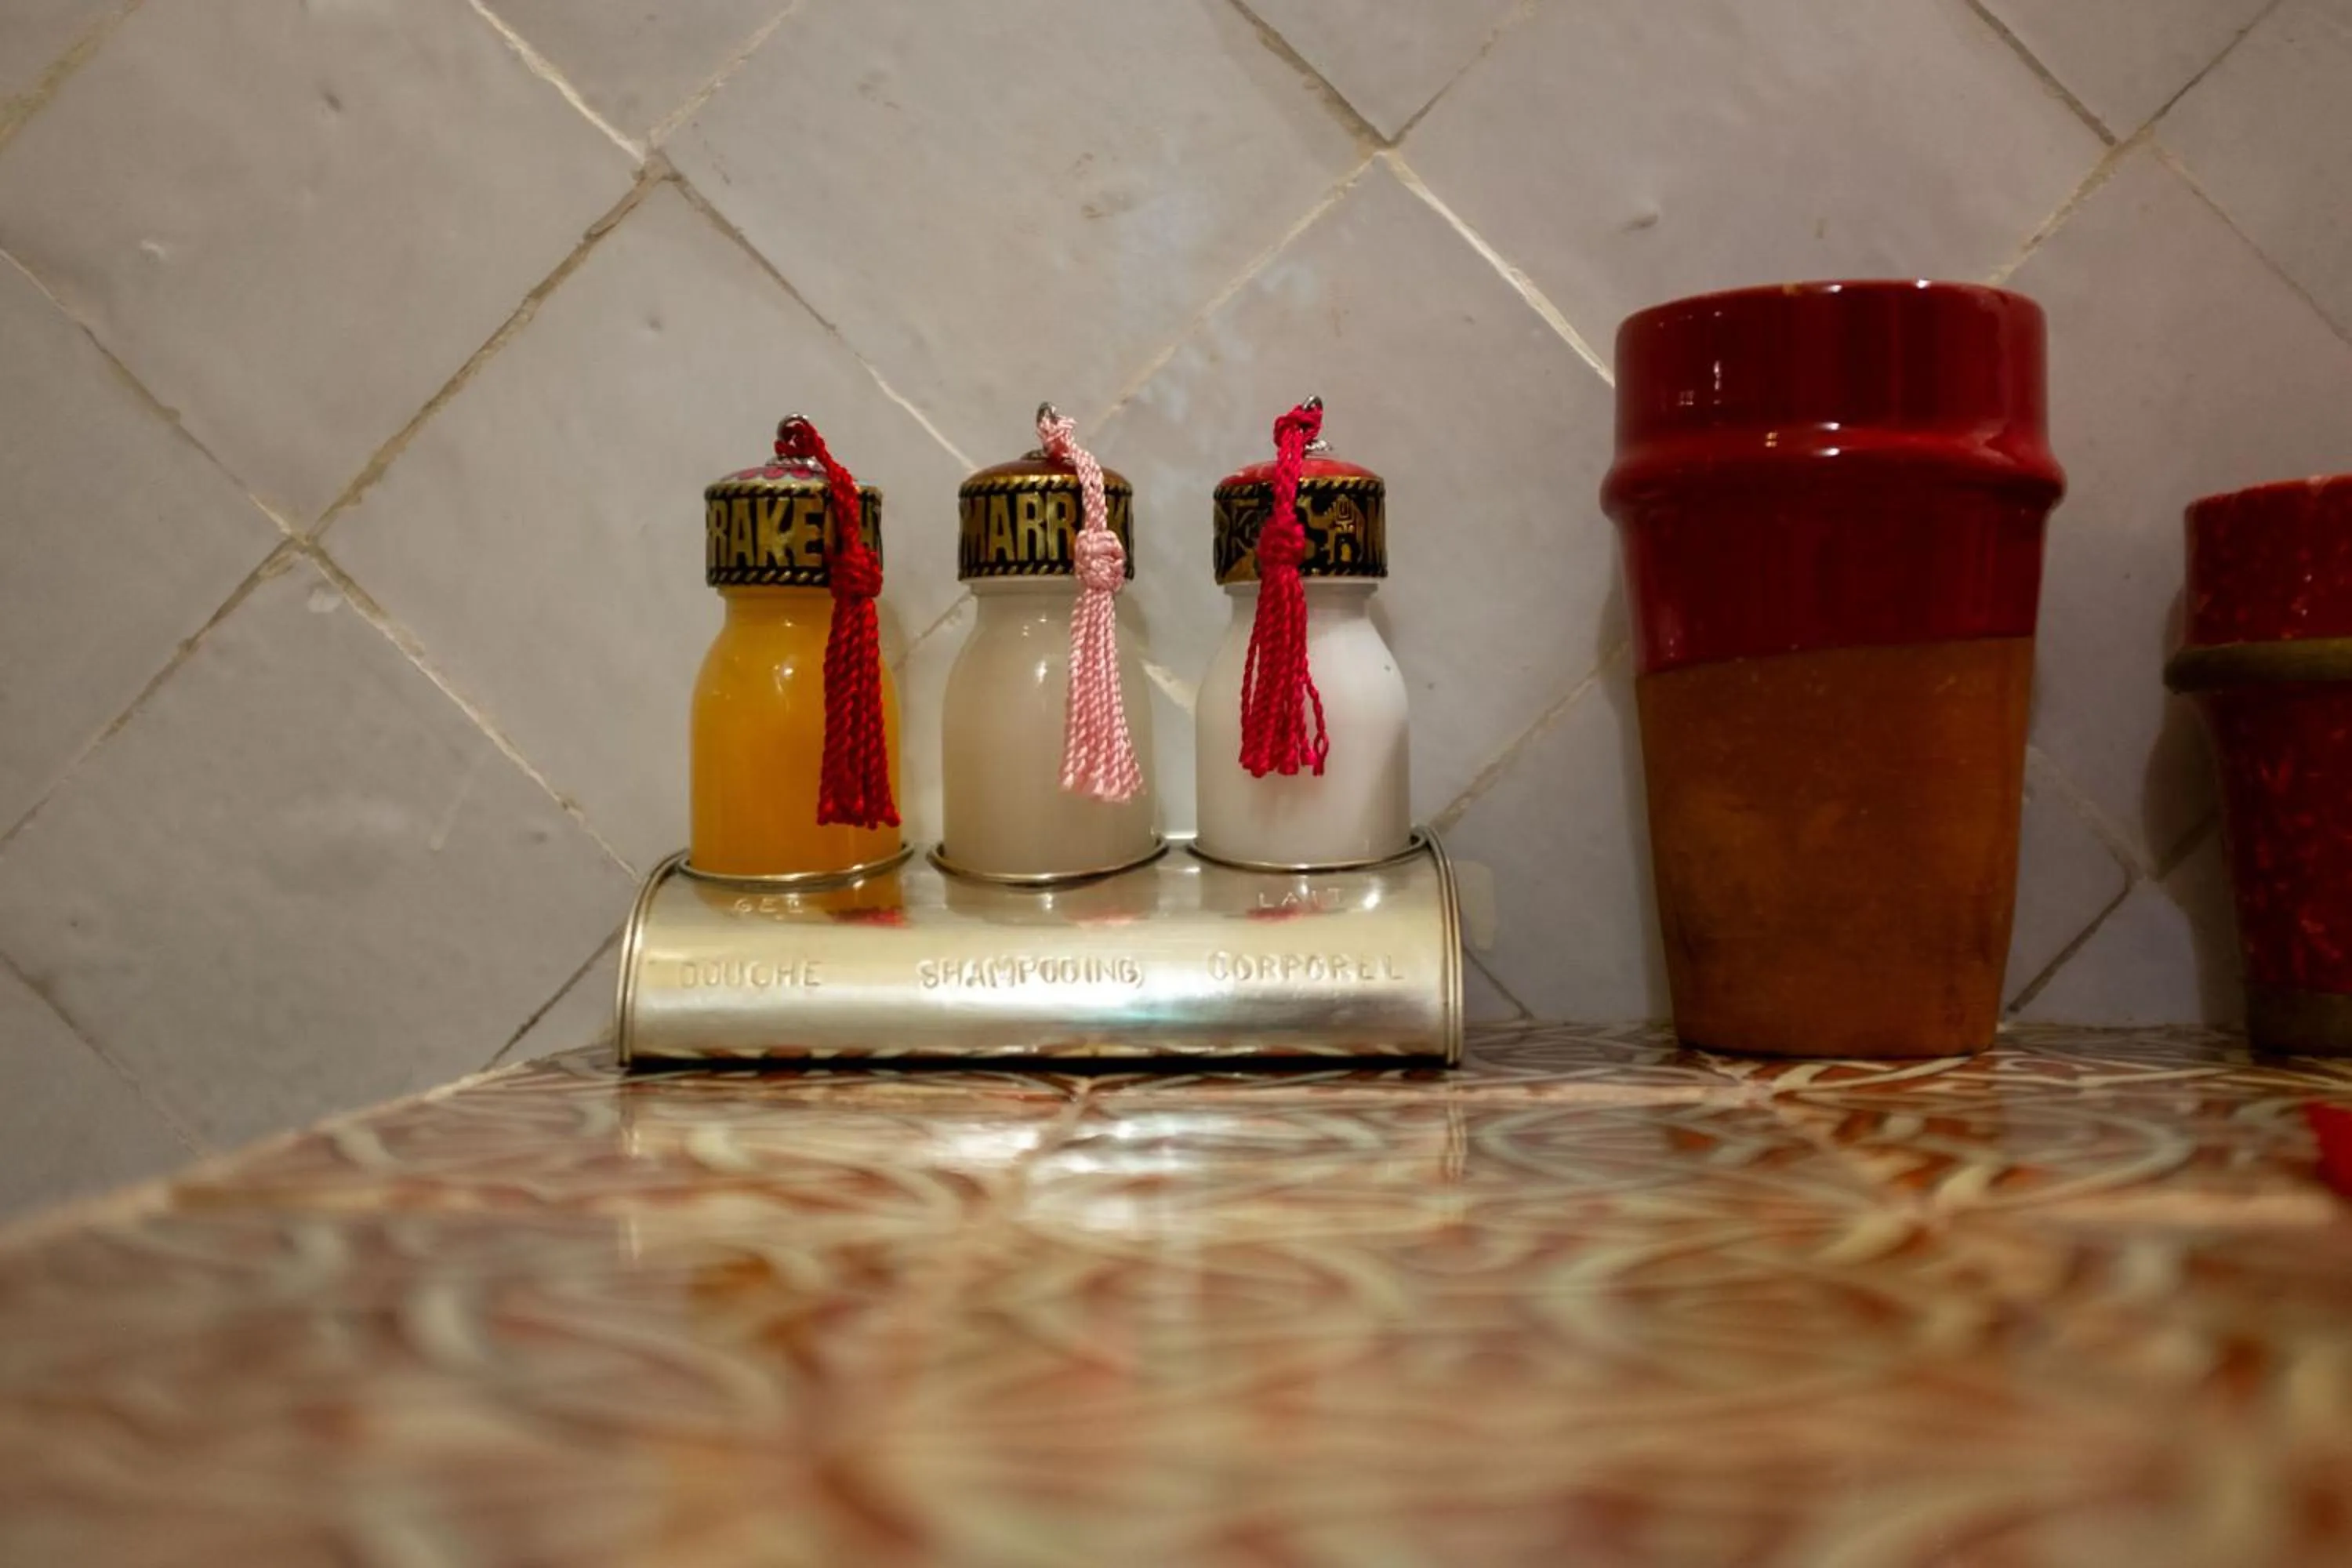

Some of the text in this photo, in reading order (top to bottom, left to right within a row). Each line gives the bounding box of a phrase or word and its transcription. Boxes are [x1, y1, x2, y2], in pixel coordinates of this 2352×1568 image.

[1257, 887, 1345, 909] LAIT
[679, 959, 822, 989] DOUCHE
[916, 956, 1144, 989] SHAMPOOING
[1207, 949, 1406, 983] CORPOREL
